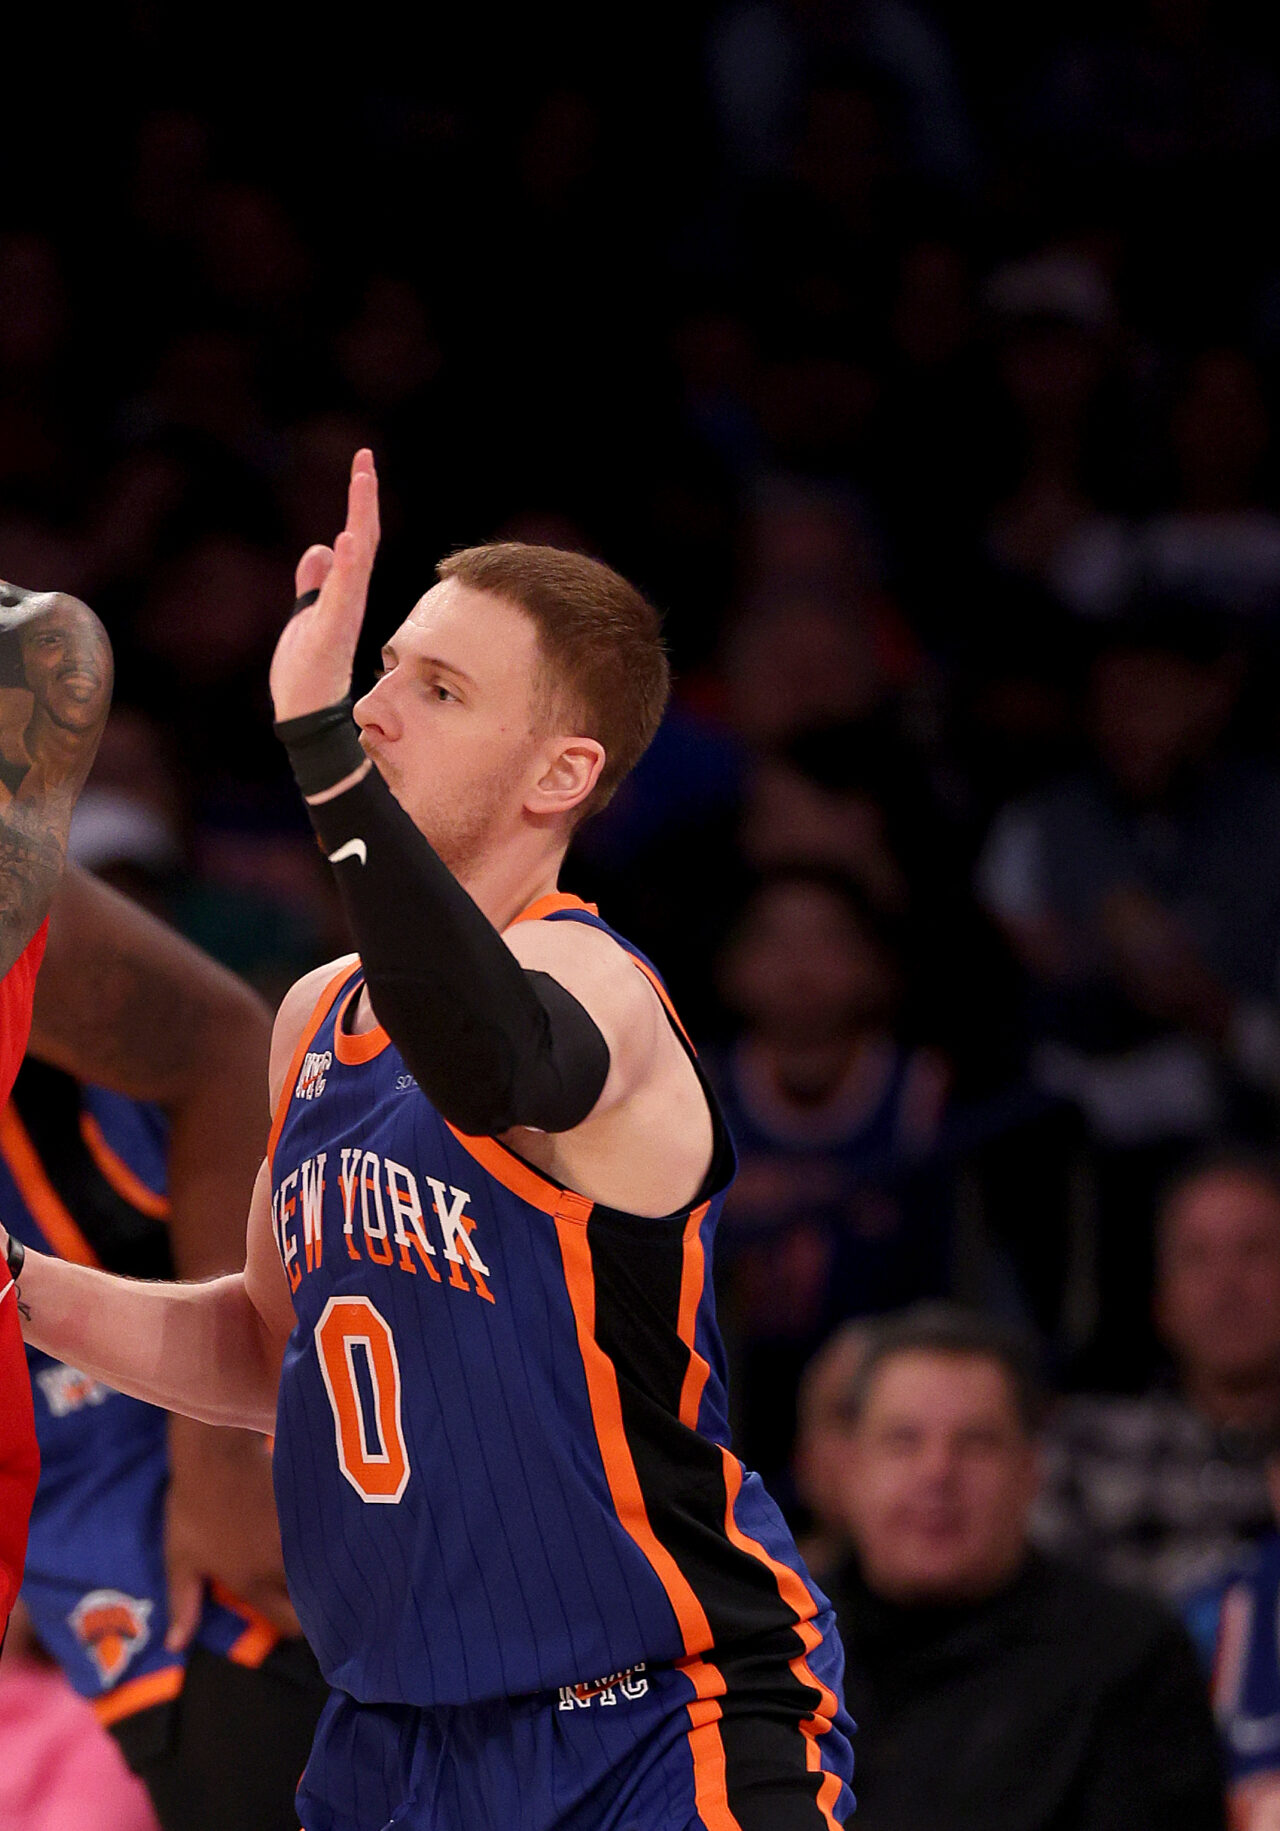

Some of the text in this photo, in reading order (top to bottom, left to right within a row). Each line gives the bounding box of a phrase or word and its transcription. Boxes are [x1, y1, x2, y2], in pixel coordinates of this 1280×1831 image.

[338, 1148, 495, 1304] YORK
[313, 1295, 411, 1504] 0
[558, 1662, 649, 1711] NYC
